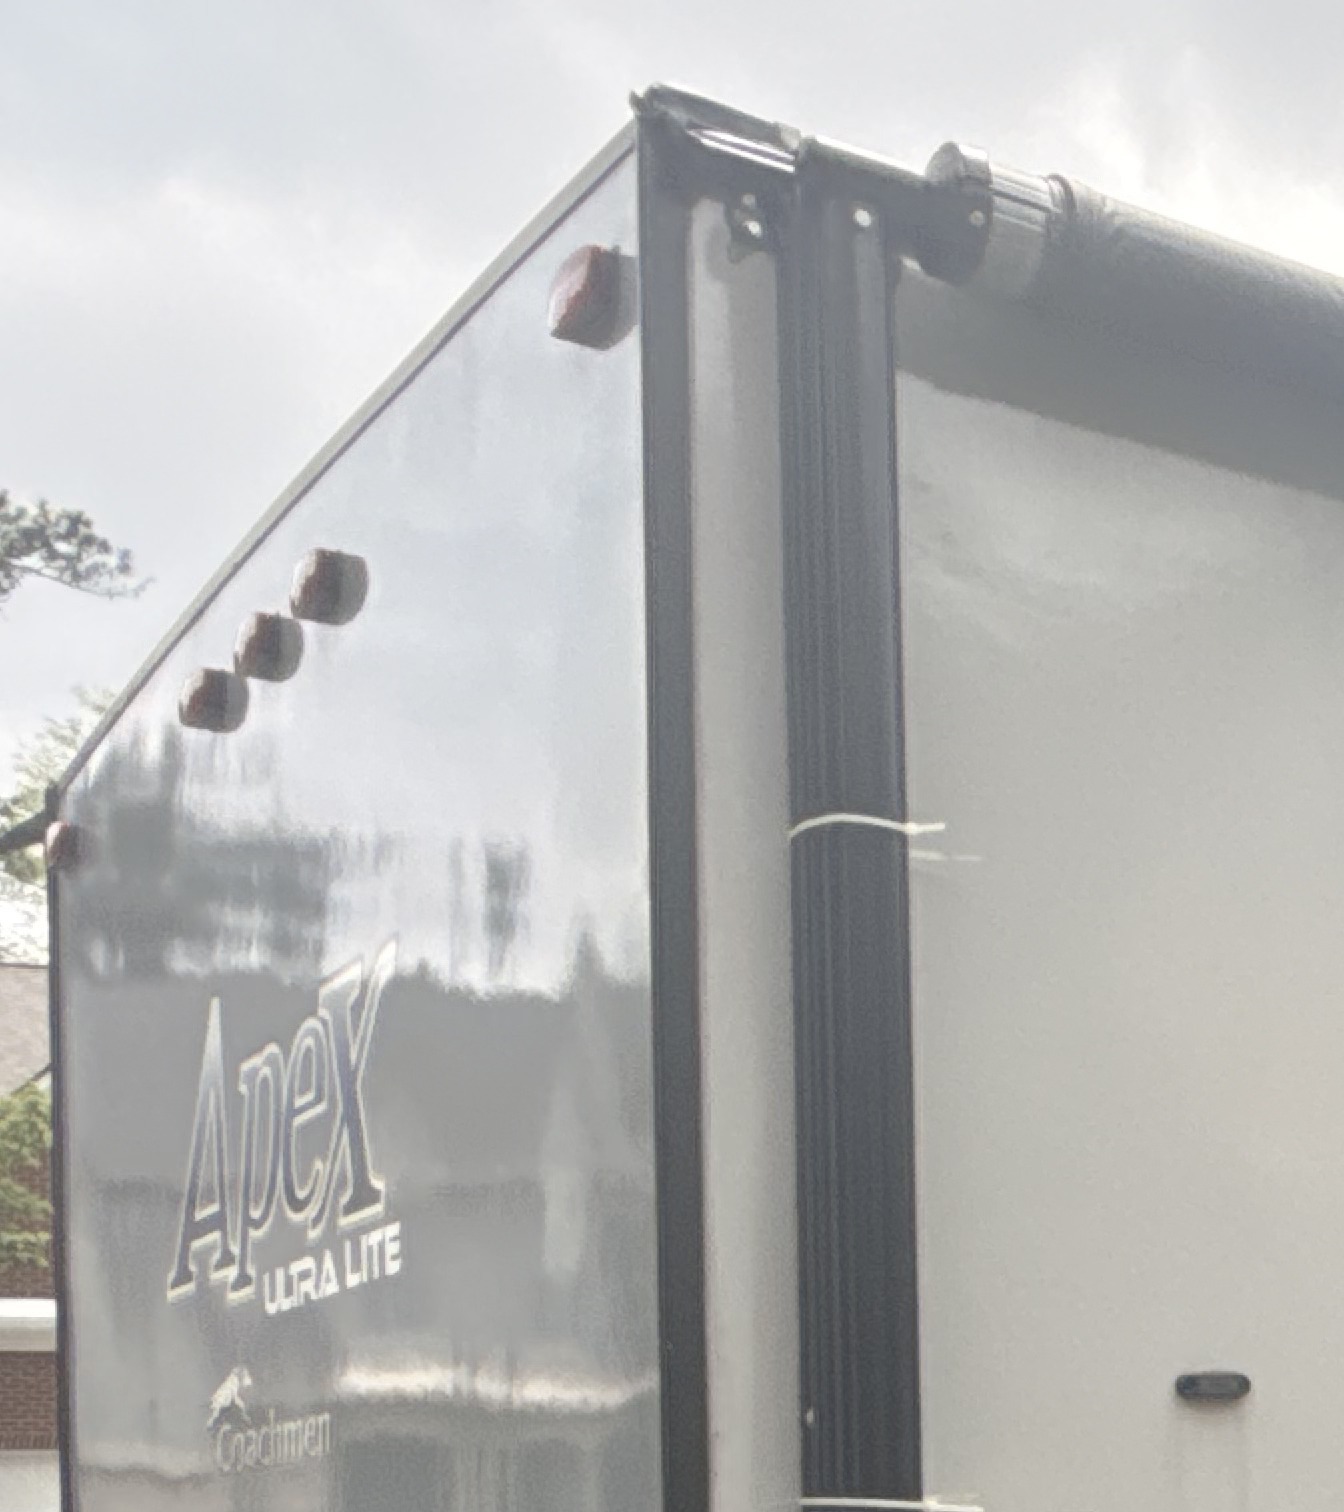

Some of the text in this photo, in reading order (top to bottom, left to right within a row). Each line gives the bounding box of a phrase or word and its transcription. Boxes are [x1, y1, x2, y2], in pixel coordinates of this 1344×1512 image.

[167, 934, 399, 1303] Apex
[261, 1220, 403, 1317] ULTRA LITE
